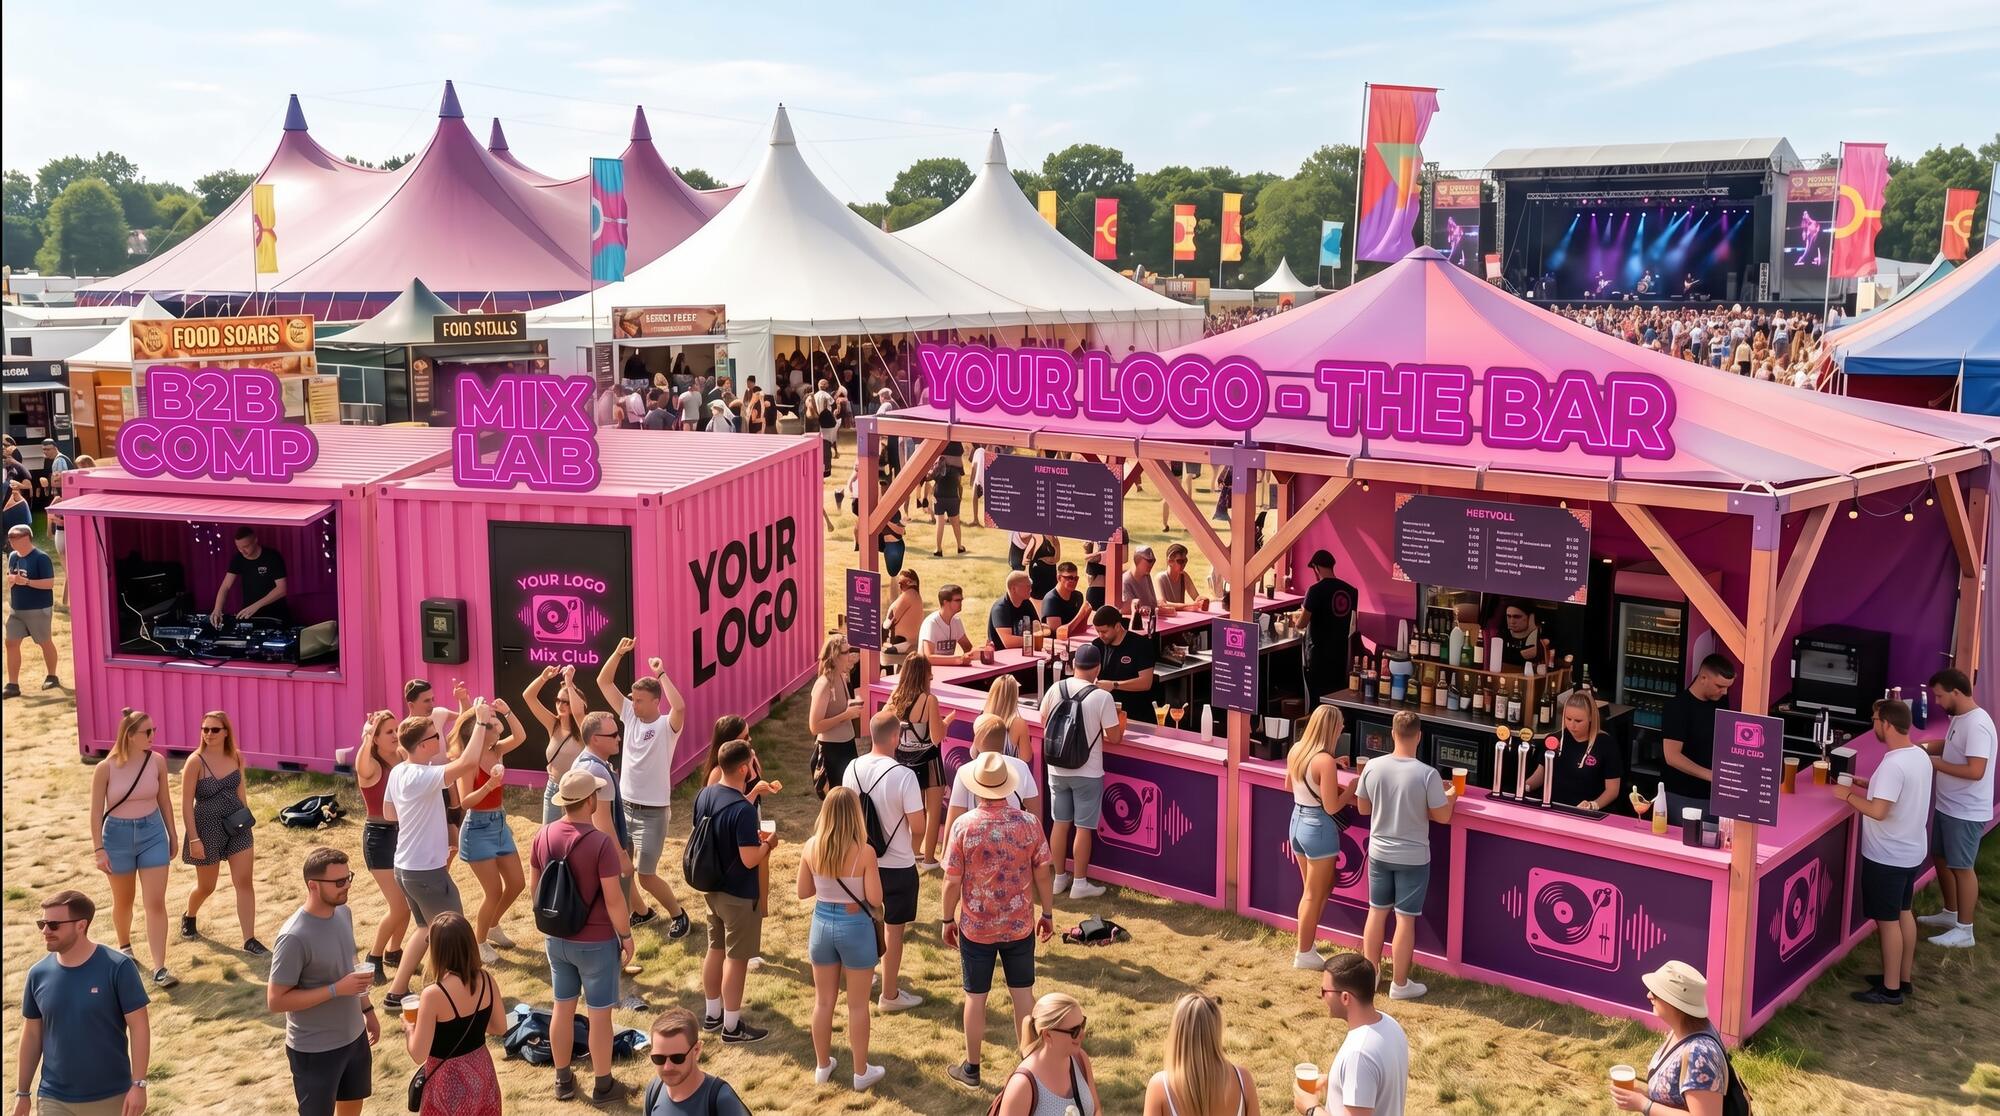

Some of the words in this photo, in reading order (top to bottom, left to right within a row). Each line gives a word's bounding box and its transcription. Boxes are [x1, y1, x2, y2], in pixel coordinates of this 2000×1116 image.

[173, 326, 221, 349] FOOD
[223, 324, 280, 347] SOARS
[150, 371, 278, 423] B2B
[460, 378, 590, 432] MIX
[921, 349, 1073, 413] YOUR
[1087, 356, 1263, 424] LOGO
[1319, 366, 1466, 438] THE
[1488, 374, 1666, 452] BAR
[120, 422, 312, 477] COMP
[458, 433, 595, 486] LAB
[517, 573, 560, 590] YOUR
[564, 573, 606, 593] LOGO
[688, 515, 797, 615] YOUR
[530, 647, 558, 662] Mix
[562, 649, 599, 664] Club
[692, 577, 798, 689] LOGO
